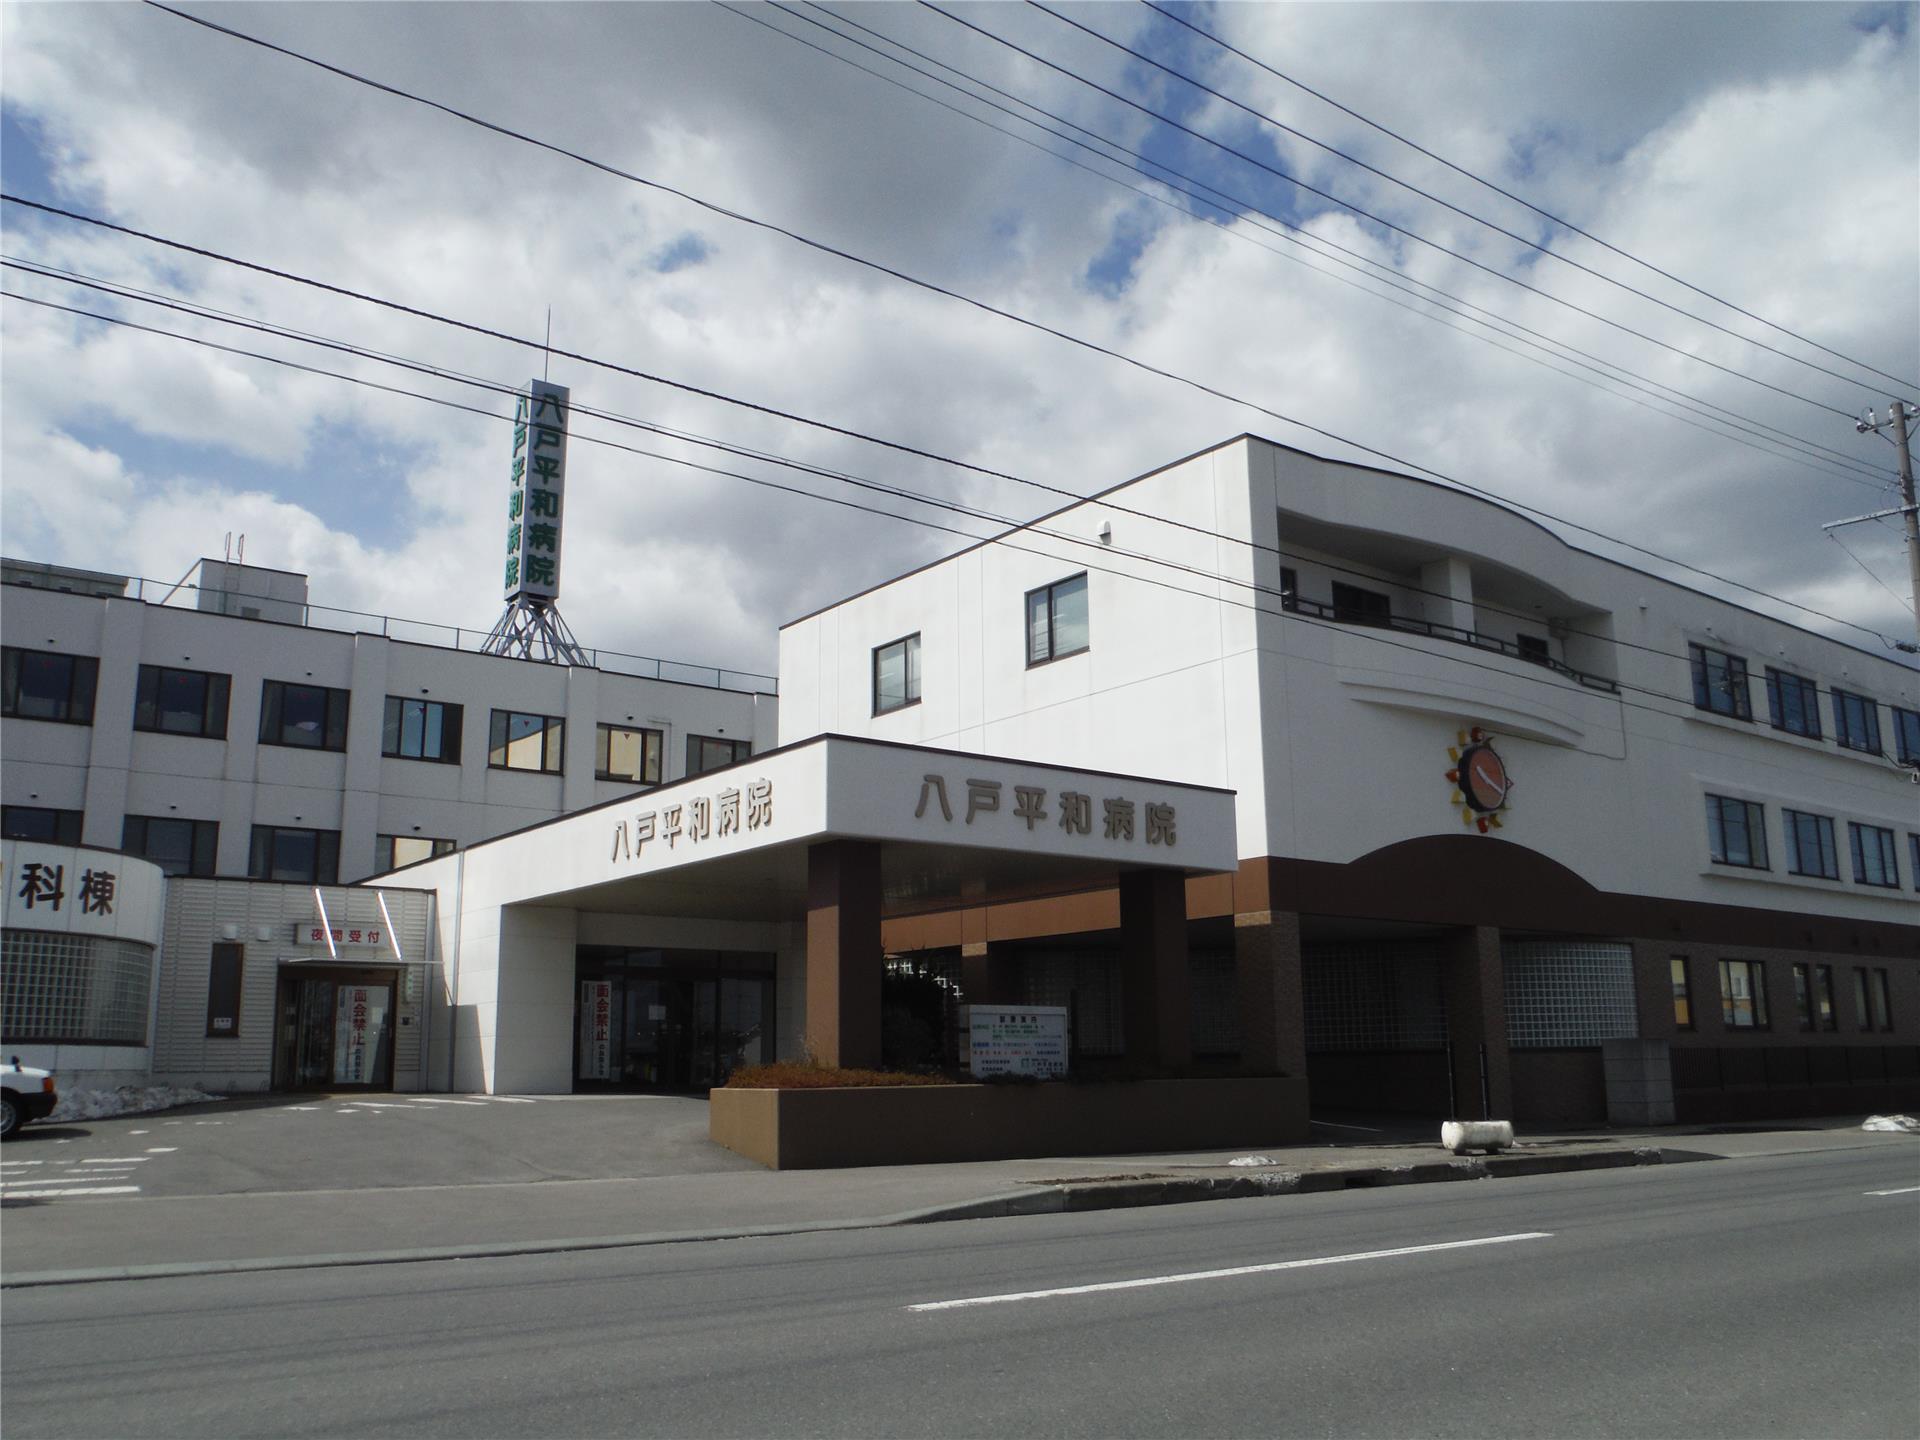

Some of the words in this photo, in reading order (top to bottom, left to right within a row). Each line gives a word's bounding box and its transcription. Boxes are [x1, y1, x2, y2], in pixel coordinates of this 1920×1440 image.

[505, 394, 528, 589] 八戸平和病院
[525, 391, 564, 587] 八戸平和病院
[611, 777, 773, 864] 八戸平和病院
[914, 774, 1177, 847] 八戸平和病院
[0, 862, 116, 917] 科棟
[311, 928, 381, 944] 夜間受付
[352, 989, 368, 1046] 面会禁止
[595, 983, 609, 1041] 面会禁止
